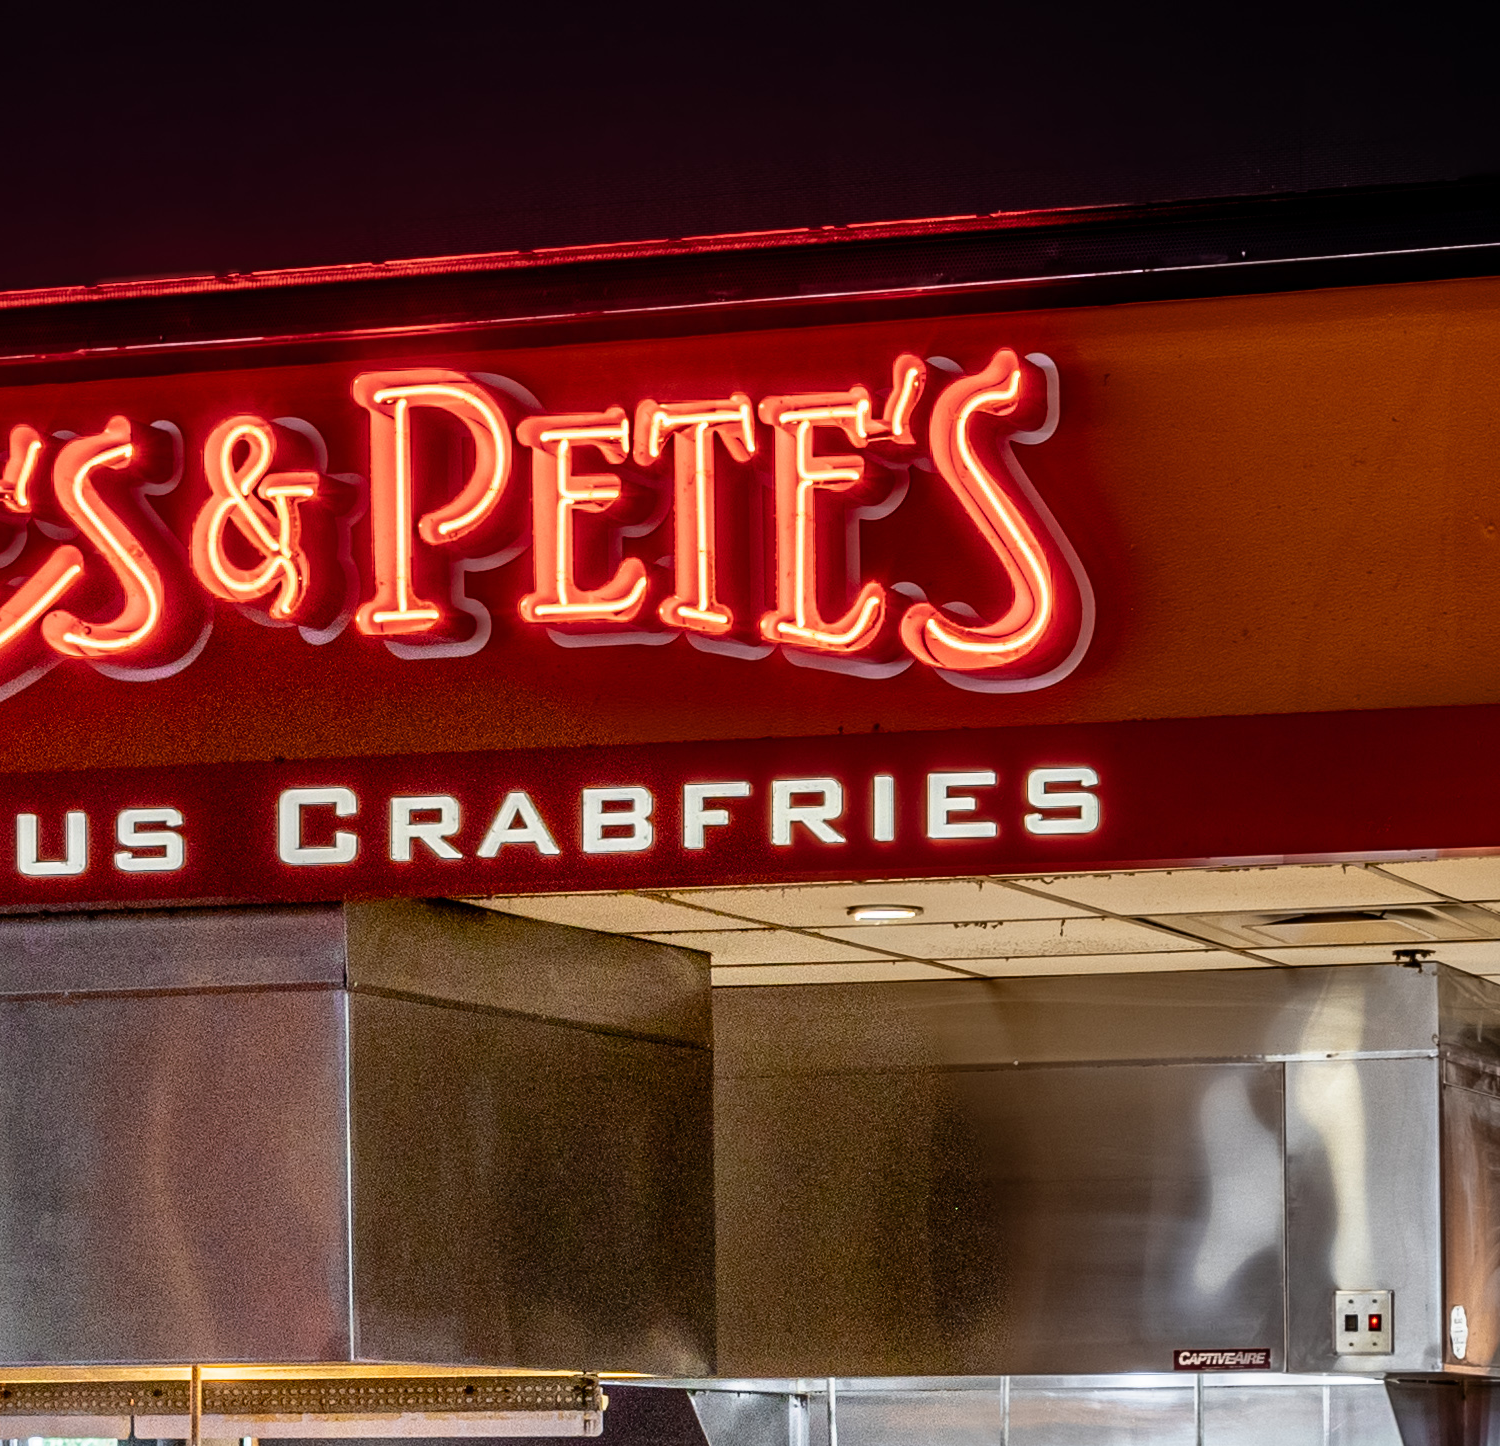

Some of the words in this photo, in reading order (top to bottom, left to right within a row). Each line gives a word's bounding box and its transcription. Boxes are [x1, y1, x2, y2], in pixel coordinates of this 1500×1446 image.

[190, 414, 321, 618] &
[353, 347, 1057, 670] PETE'S
[277, 767, 1101, 867] CRABFRIES
